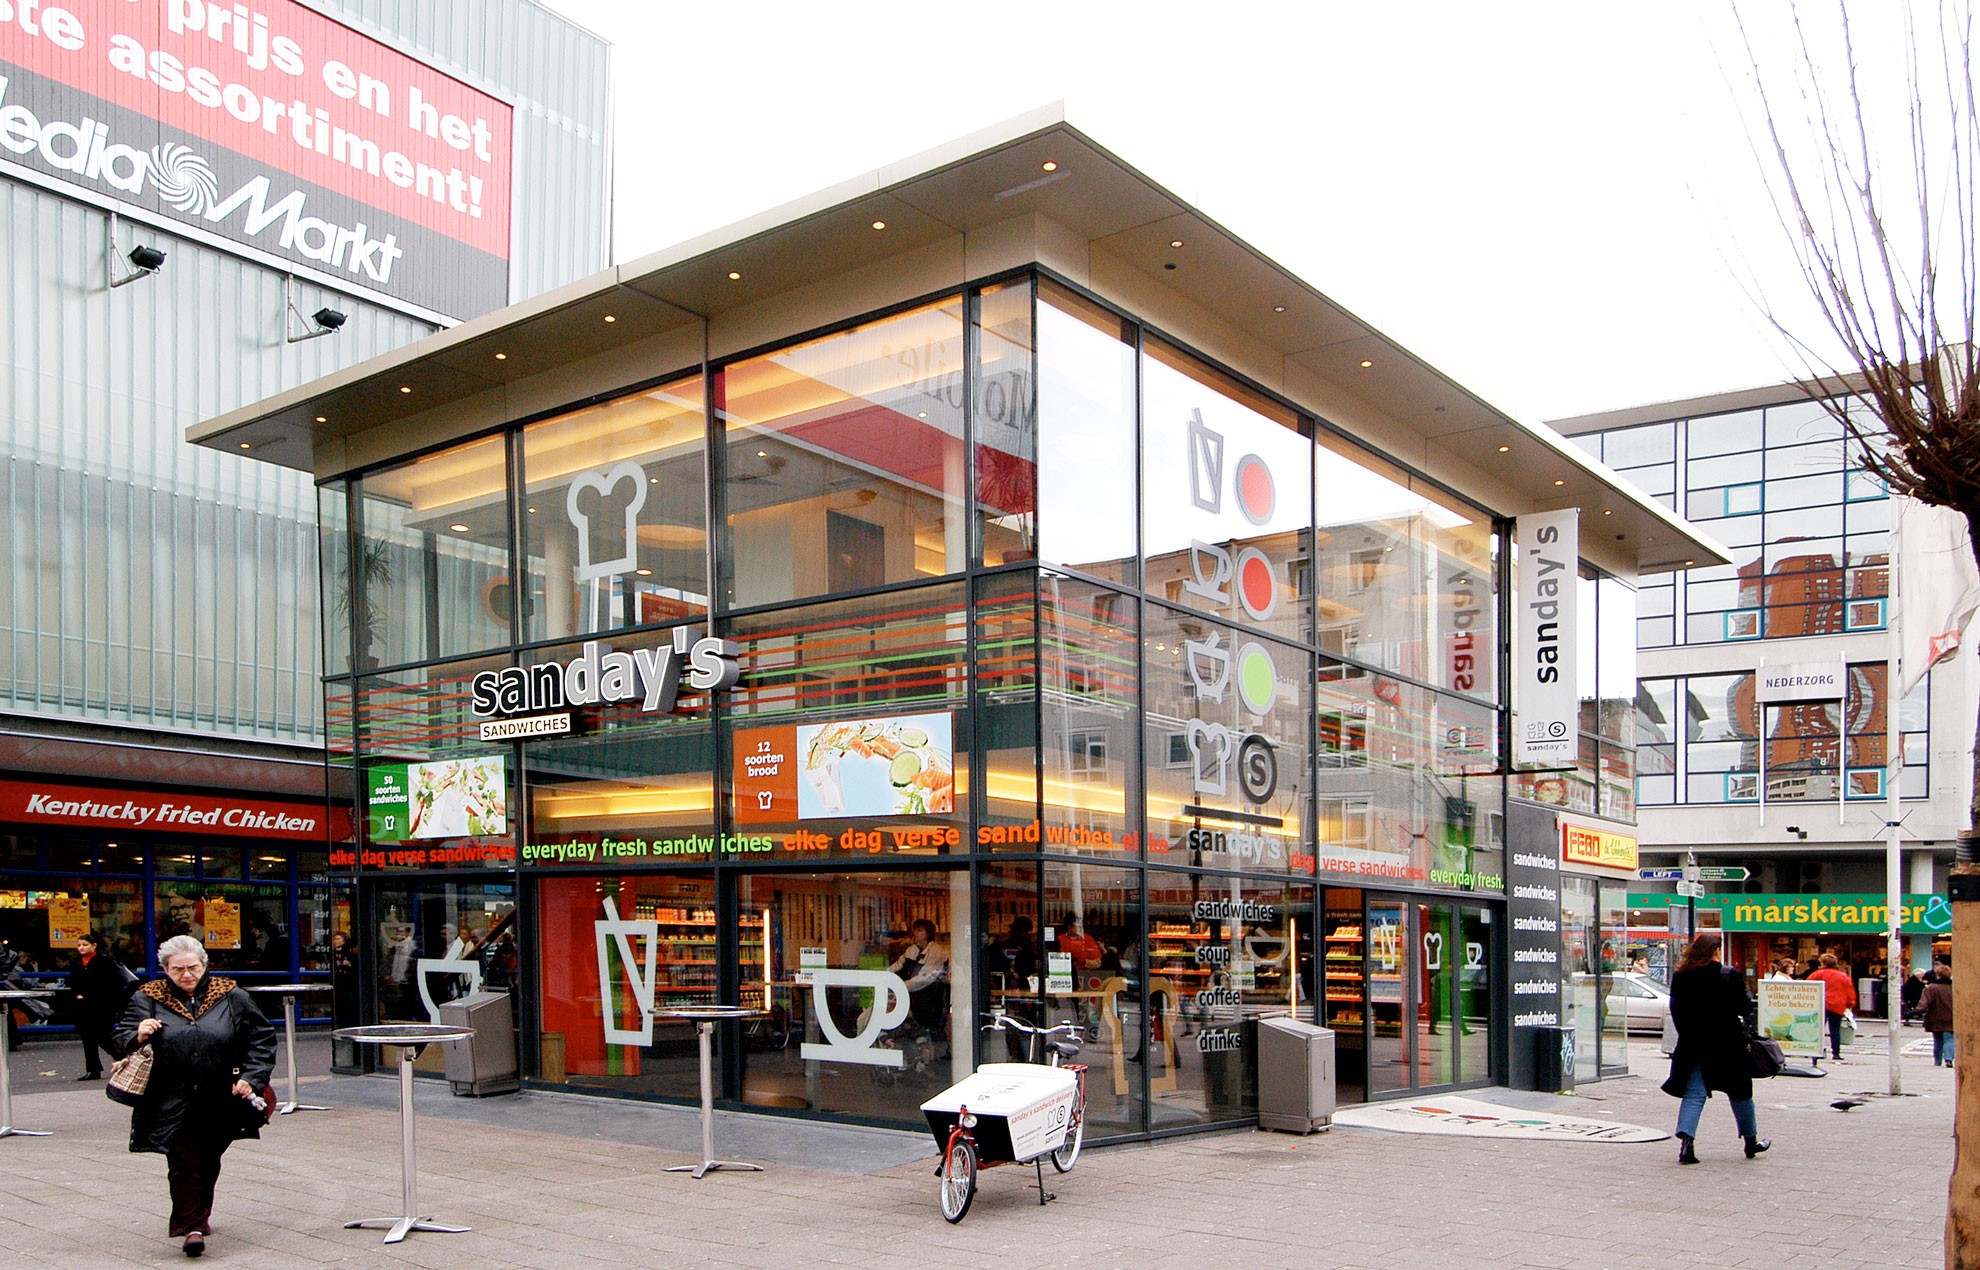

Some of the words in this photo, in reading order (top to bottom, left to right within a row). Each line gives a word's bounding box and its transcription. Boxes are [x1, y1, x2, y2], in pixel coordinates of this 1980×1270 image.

[167, 0, 304, 75] prijs
[323, 60, 390, 118] en
[409, 86, 493, 162] het
[109, 34, 484, 219] assortiment!
[0, 75, 153, 196] edia
[207, 176, 403, 284] Markt
[1530, 525, 1565, 684] sanday's
[471, 625, 741, 716] sanday's
[1765, 674, 1835, 687] NEDERZORG
[483, 717, 568, 738] SANDWICHES
[757, 741, 771, 753] 12
[1527, 743, 1568, 751] sanday's
[744, 752, 784, 765] soorten
[384, 776, 393, 785] 50
[747, 764, 778, 778] brood
[369, 794, 408, 805] sandwiches
[375, 785, 400, 795] soorten
[25, 794, 153, 826] Kentucky
[156, 803, 222, 826] Fried
[224, 808, 316, 833] Chicken
[783, 829, 830, 852] elke
[839, 827, 882, 852] dag
[893, 825, 960, 847] verse
[1187, 828, 1282, 864] sanday's
[1570, 831, 1600, 858] FEBO
[329, 850, 355, 866] elke
[361, 849, 386, 869] dag
[388, 850, 426, 865] verse
[429, 843, 516, 863] sandwiches
[522, 839, 598, 862] everyday
[601, 838, 648, 858] fresh
[1513, 852, 1556, 870] sandwiches
[1290, 850, 1316, 874] dag
[1323, 857, 1356, 873] verse
[1430, 869, 1475, 890] everyday
[1477, 871, 1504, 890] fresh.
[1513, 884, 1556, 900] sandwiches
[1195, 898, 1274, 922] sandwiches
[1735, 899, 1925, 924] marskramer
[1513, 916, 1556, 932] sandwiches
[1196, 946, 1231, 968] soup
[1513, 947, 1556, 963] sandwiches
[1197, 986, 1241, 1008] coffee
[1513, 979, 1556, 995] sandwiches
[1513, 1011, 1556, 1026] sandwiches
[1197, 1028, 1242, 1052] drinks
